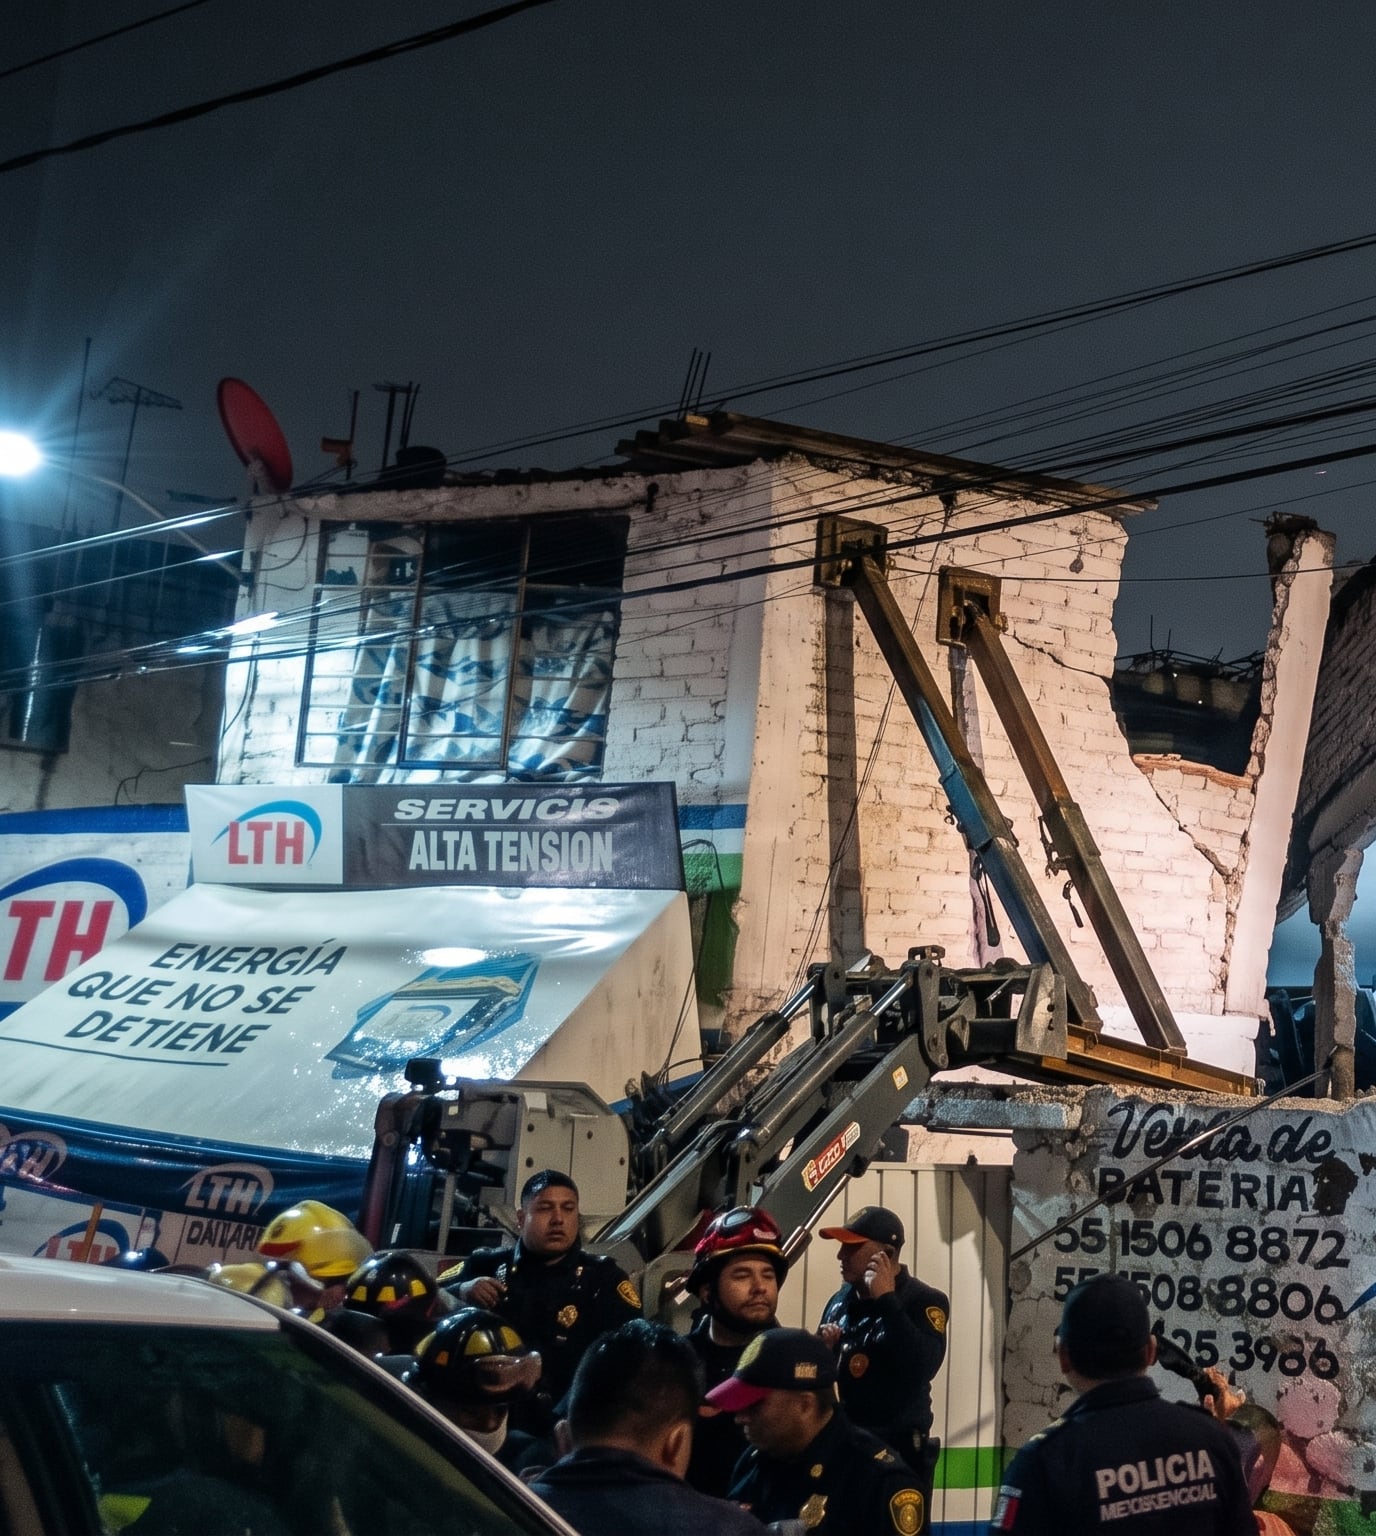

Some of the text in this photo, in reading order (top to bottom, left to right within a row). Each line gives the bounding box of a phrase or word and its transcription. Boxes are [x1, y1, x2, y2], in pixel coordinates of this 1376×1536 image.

[227, 820, 305, 866] LTH
[409, 830, 613, 872] ALTA TENSION
[150, 938, 348, 975] ENERGÍA
[68, 971, 315, 1014] QUE NO SE
[64, 1010, 271, 1053] DETIENE
[1107, 1102, 1335, 1164] Venta de
[185, 1173, 259, 1215] LTH
[1054, 1217, 1350, 1270] 55 1506 8872
[1215, 1274, 1350, 1325] 8806
[1096, 1449, 1216, 1499] POLICIA
